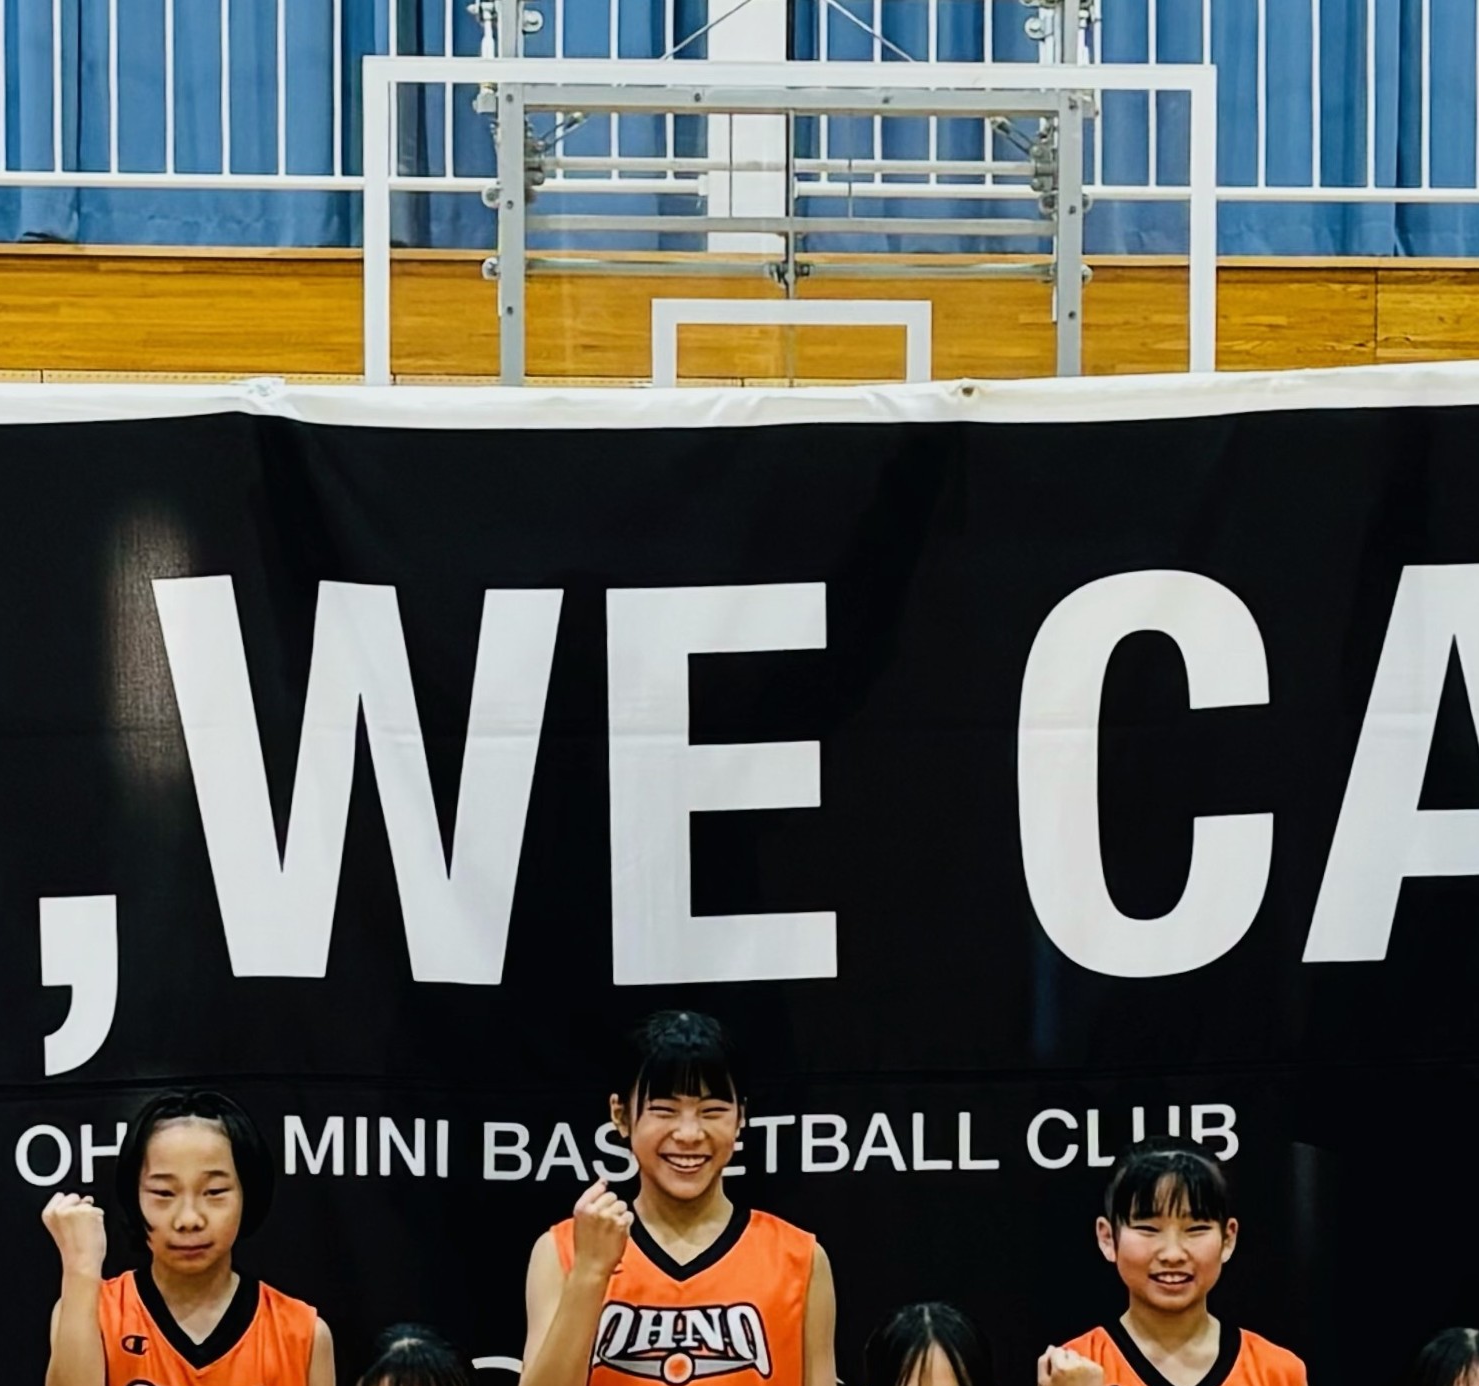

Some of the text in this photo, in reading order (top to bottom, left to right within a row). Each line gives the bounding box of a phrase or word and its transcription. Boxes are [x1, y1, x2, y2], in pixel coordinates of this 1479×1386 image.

[15, 1121, 128, 1187] OH
[283, 1114, 449, 1179] MINI
[482, 1111, 1000, 1183] BASTBALL
[590, 1300, 772, 1379] OHNO
